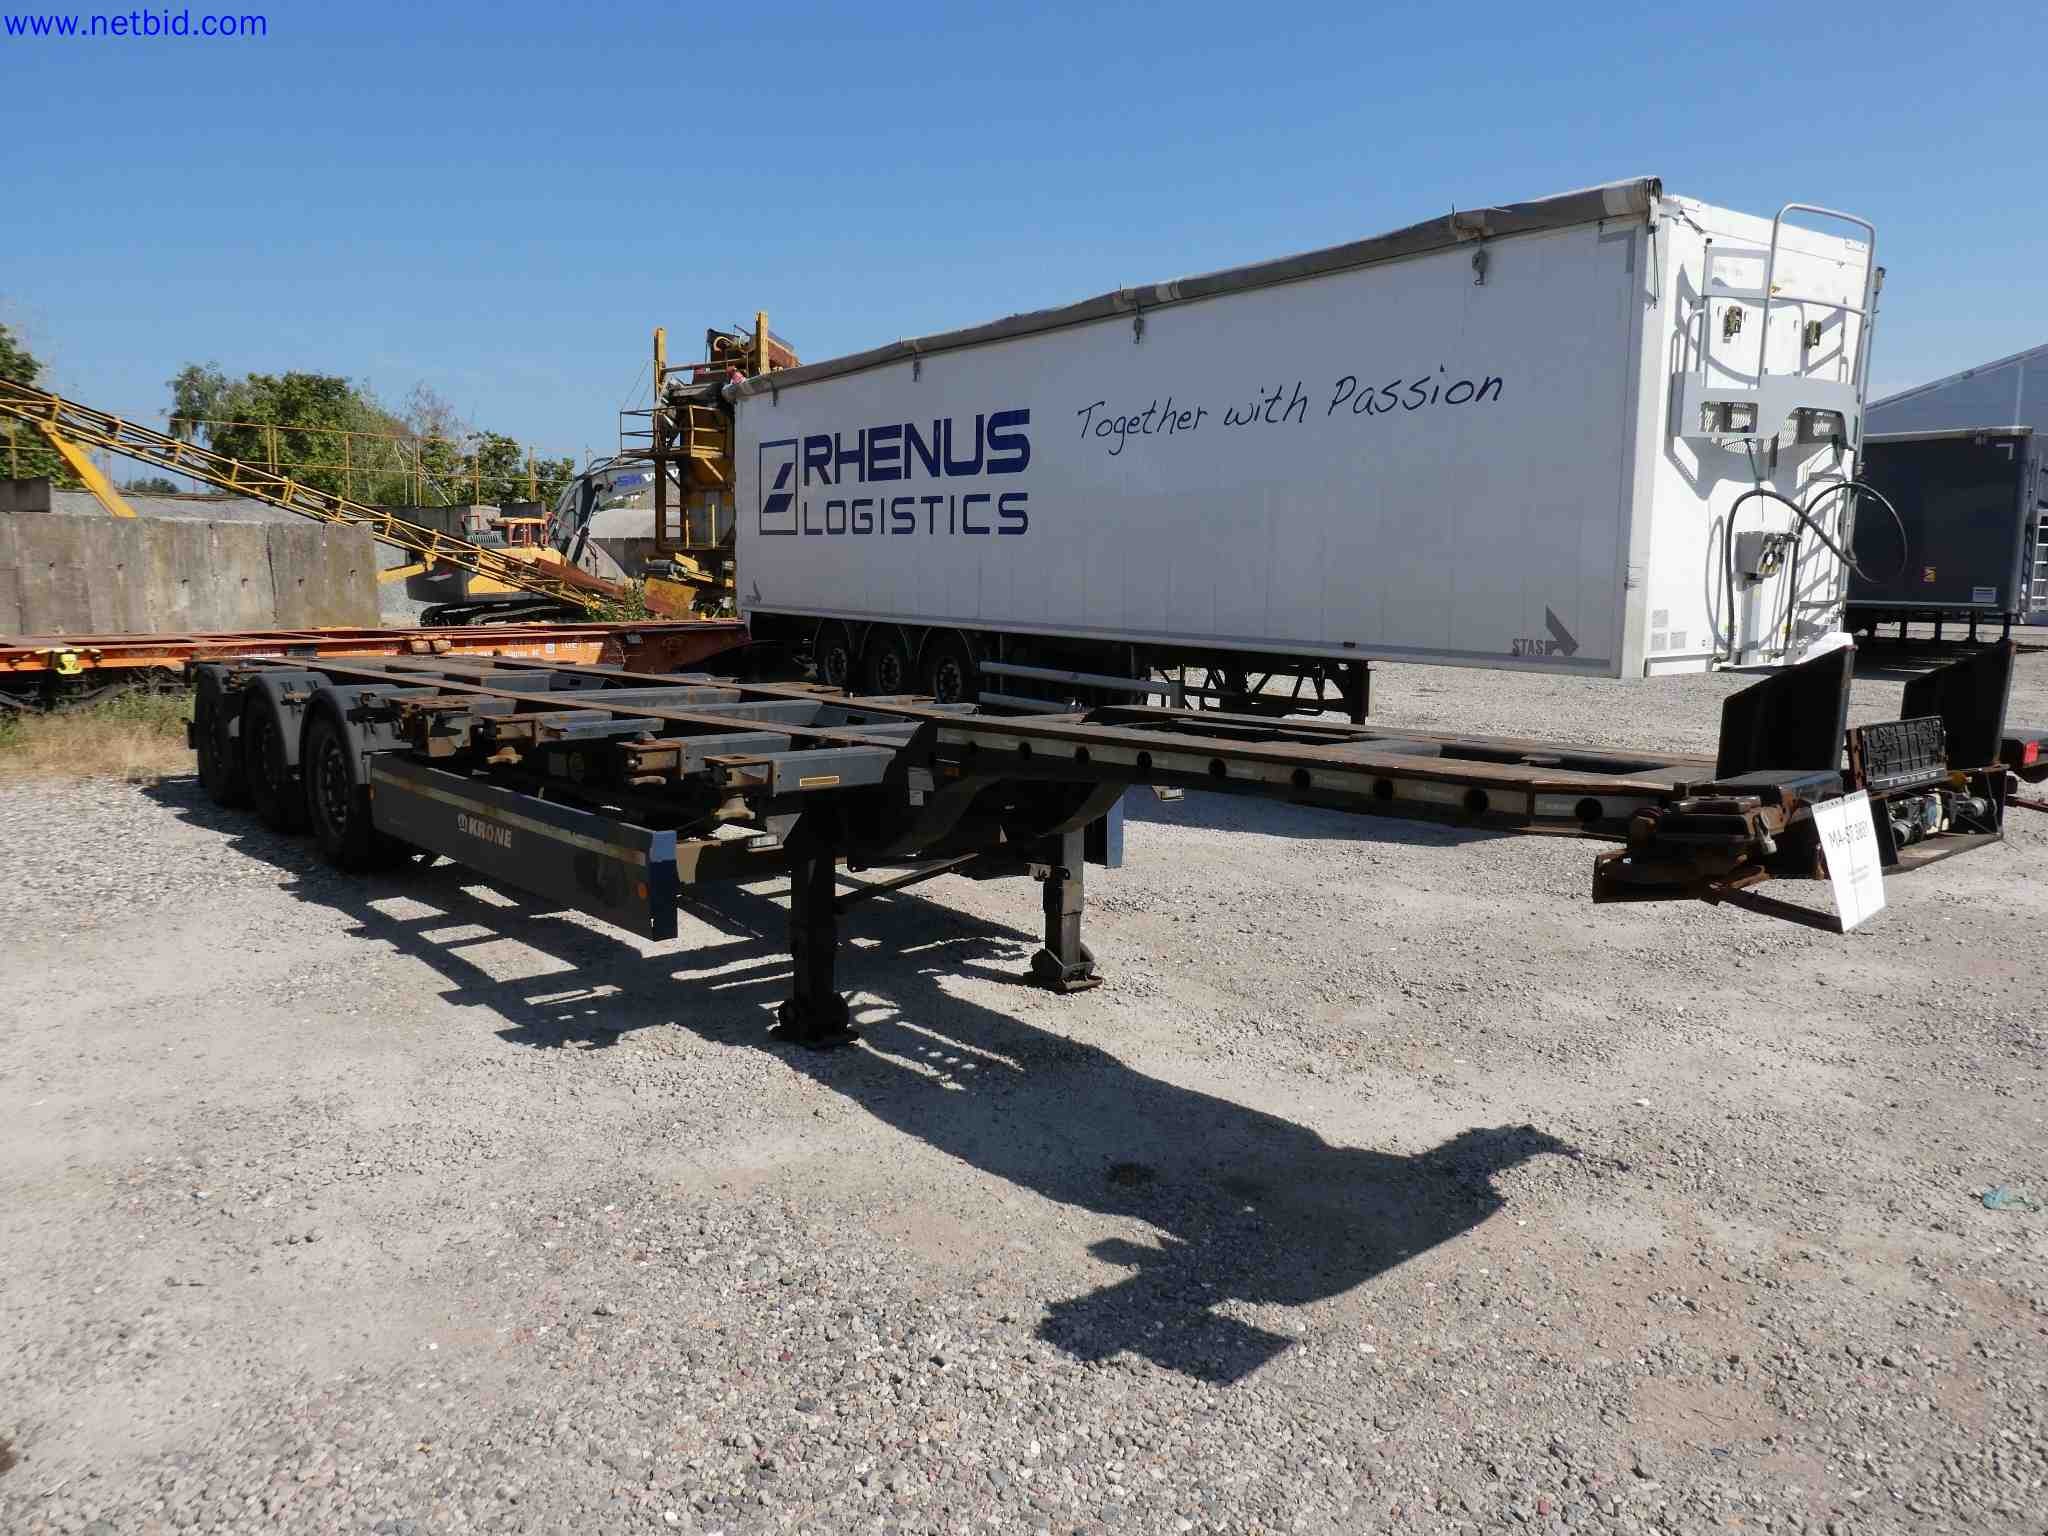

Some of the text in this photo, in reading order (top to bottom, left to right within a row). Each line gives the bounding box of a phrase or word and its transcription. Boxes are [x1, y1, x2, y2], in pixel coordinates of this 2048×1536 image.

[1076, 363, 1504, 456] Together with Passion
[803, 408, 1031, 487] RHENUS
[803, 492, 1030, 536] LOGISTICS
[1512, 638, 1544, 656] STAS
[468, 817, 512, 848] KRONE
